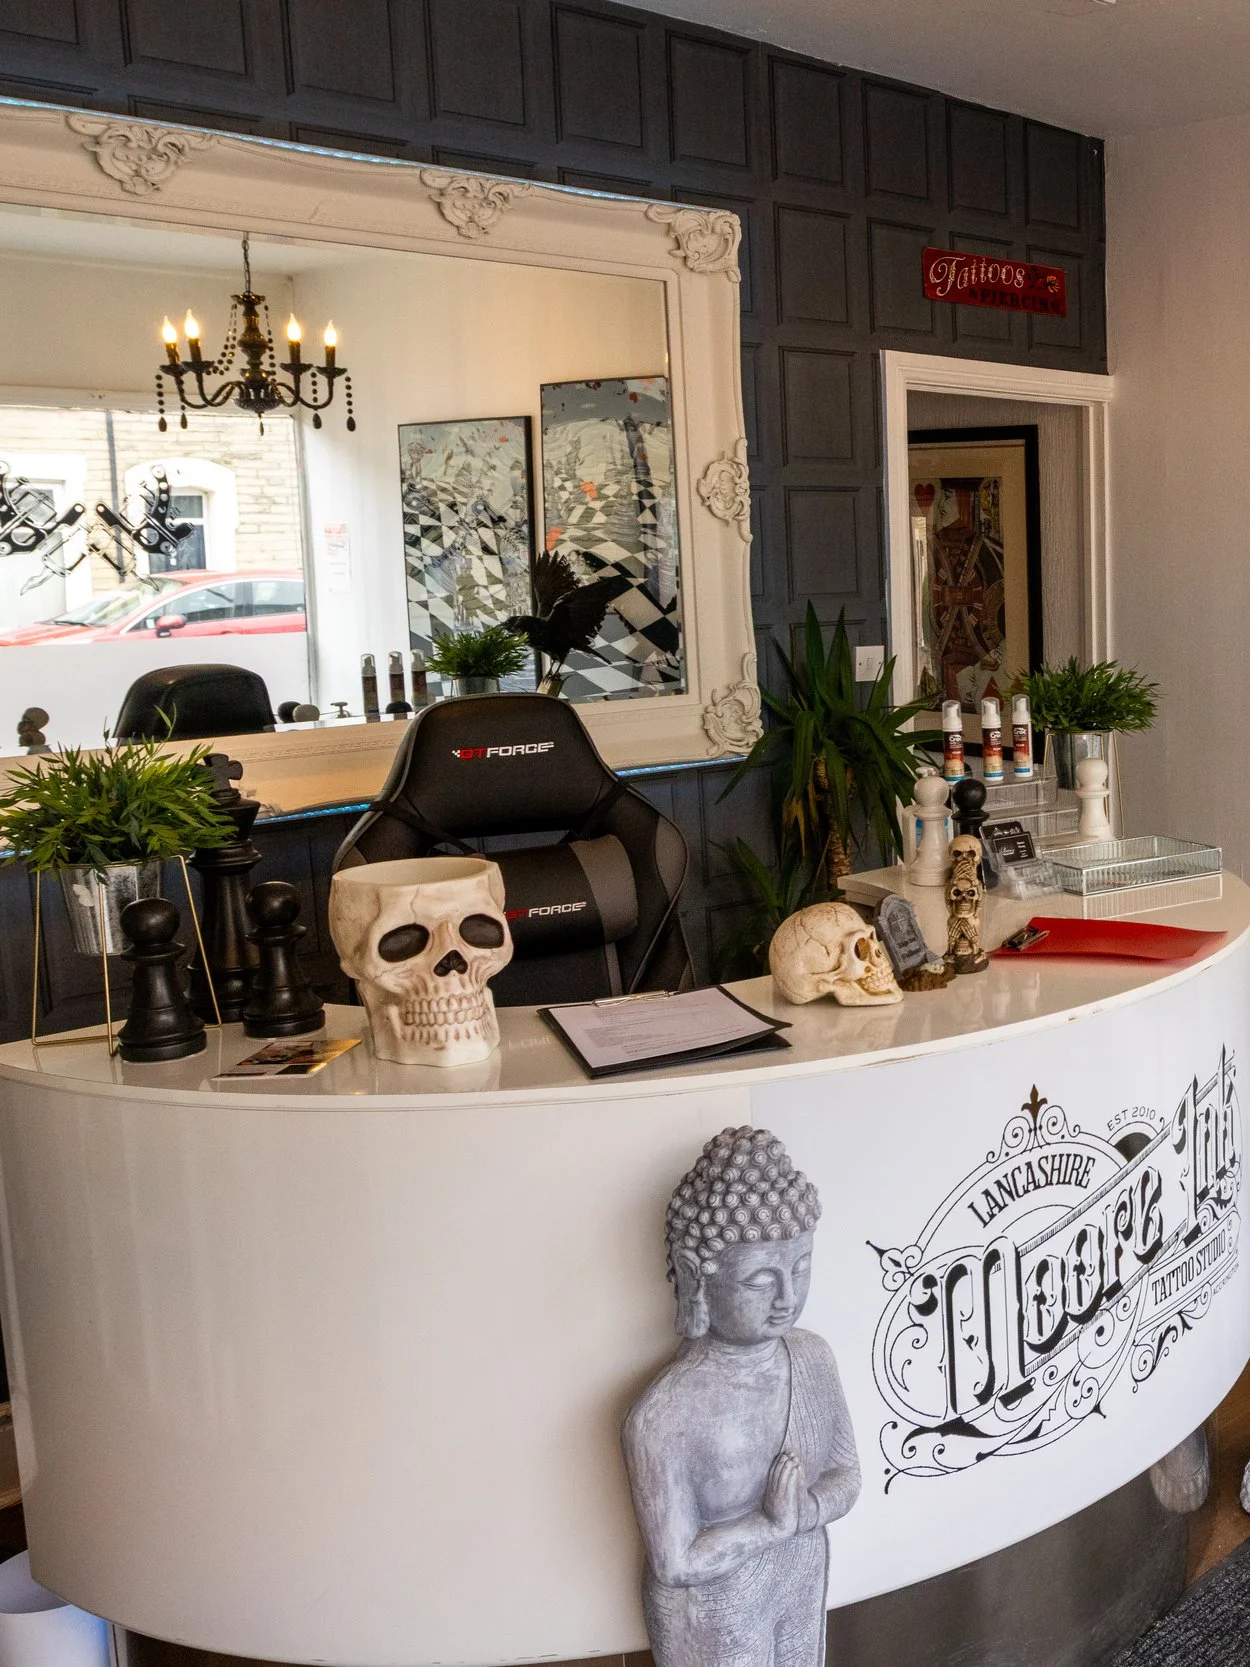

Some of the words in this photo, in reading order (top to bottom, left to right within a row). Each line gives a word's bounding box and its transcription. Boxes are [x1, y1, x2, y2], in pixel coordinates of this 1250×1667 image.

[929, 256, 1025, 297] Tattoos
[1106, 1109, 1129, 1132] EST
[1132, 1106, 1157, 1121] 2010
[967, 1153, 1097, 1229] LANCASHIRE
[1151, 1256, 1195, 1307] TATTOO
[1195, 1228, 1226, 1277] STUDIO
